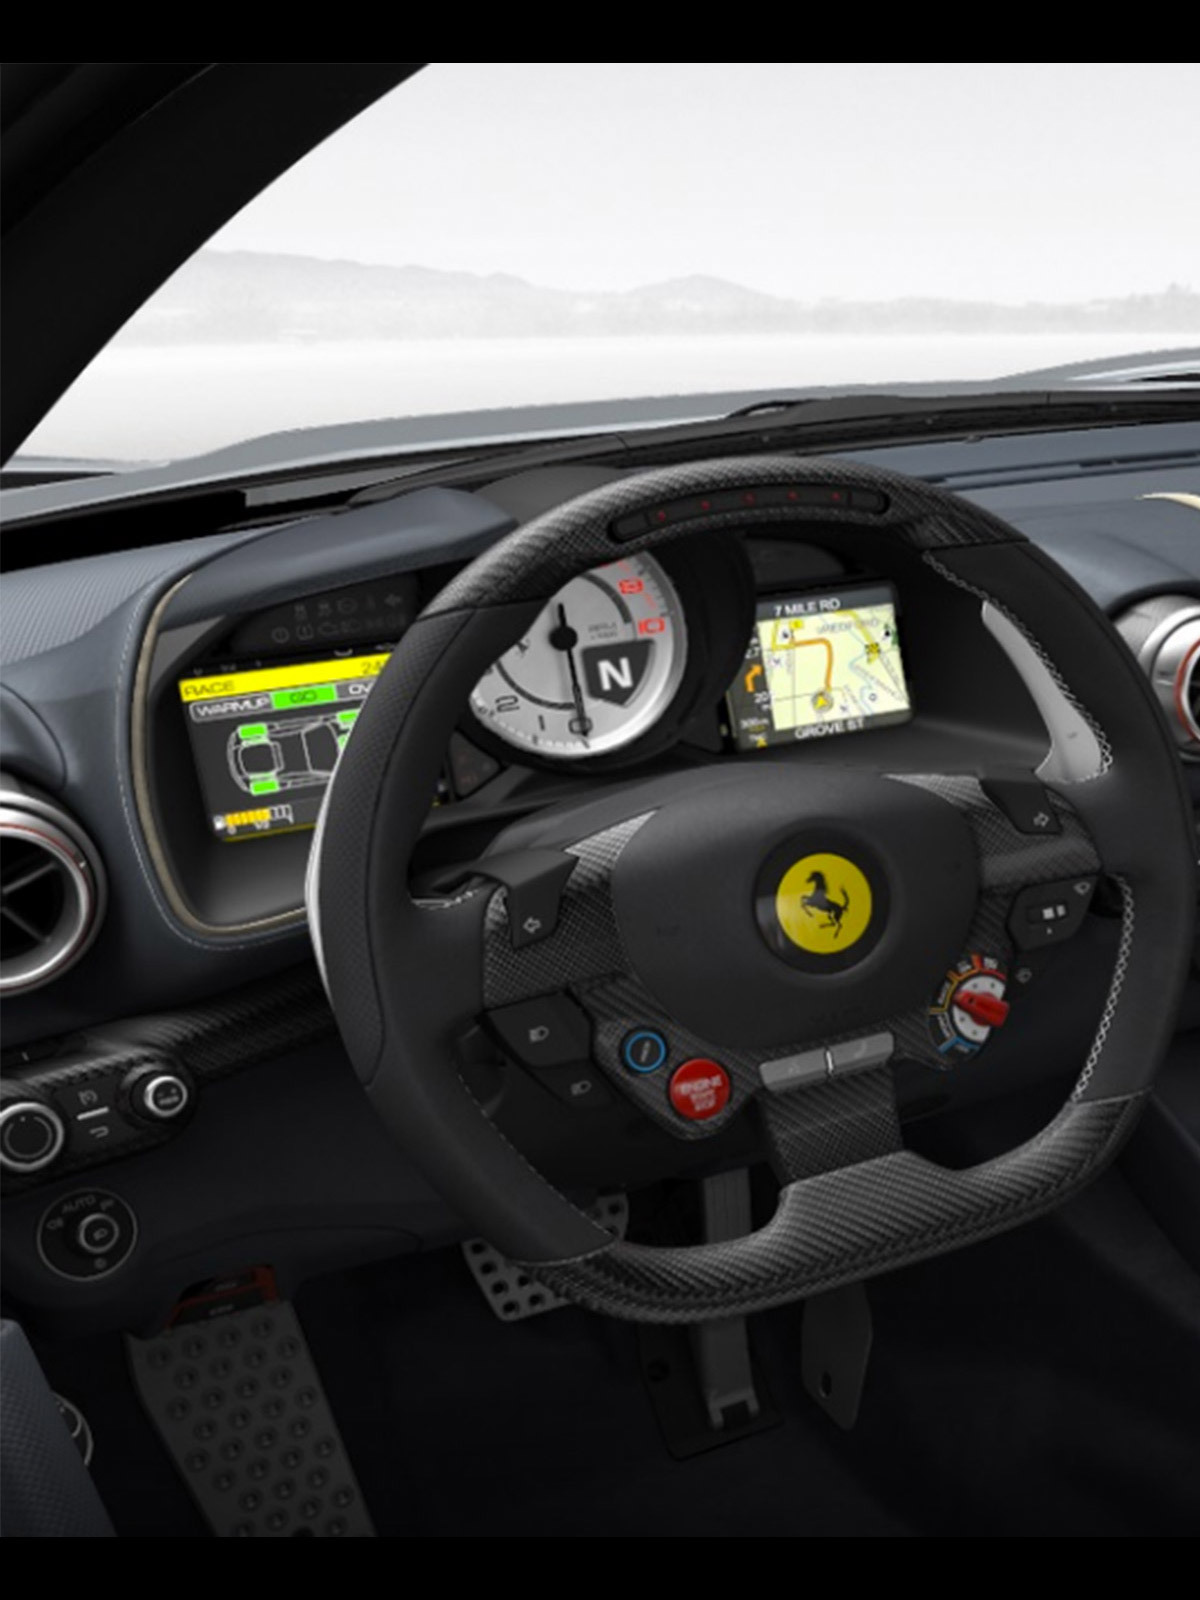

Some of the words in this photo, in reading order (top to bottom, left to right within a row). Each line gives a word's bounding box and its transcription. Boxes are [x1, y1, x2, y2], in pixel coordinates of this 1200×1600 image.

[784, 601, 818, 616] MILE
[819, 597, 841, 611] RD
[597, 656, 634, 692] N
[184, 680, 236, 698] RACE
[196, 696, 270, 717] WARMUP
[794, 721, 846, 740] GROVE
